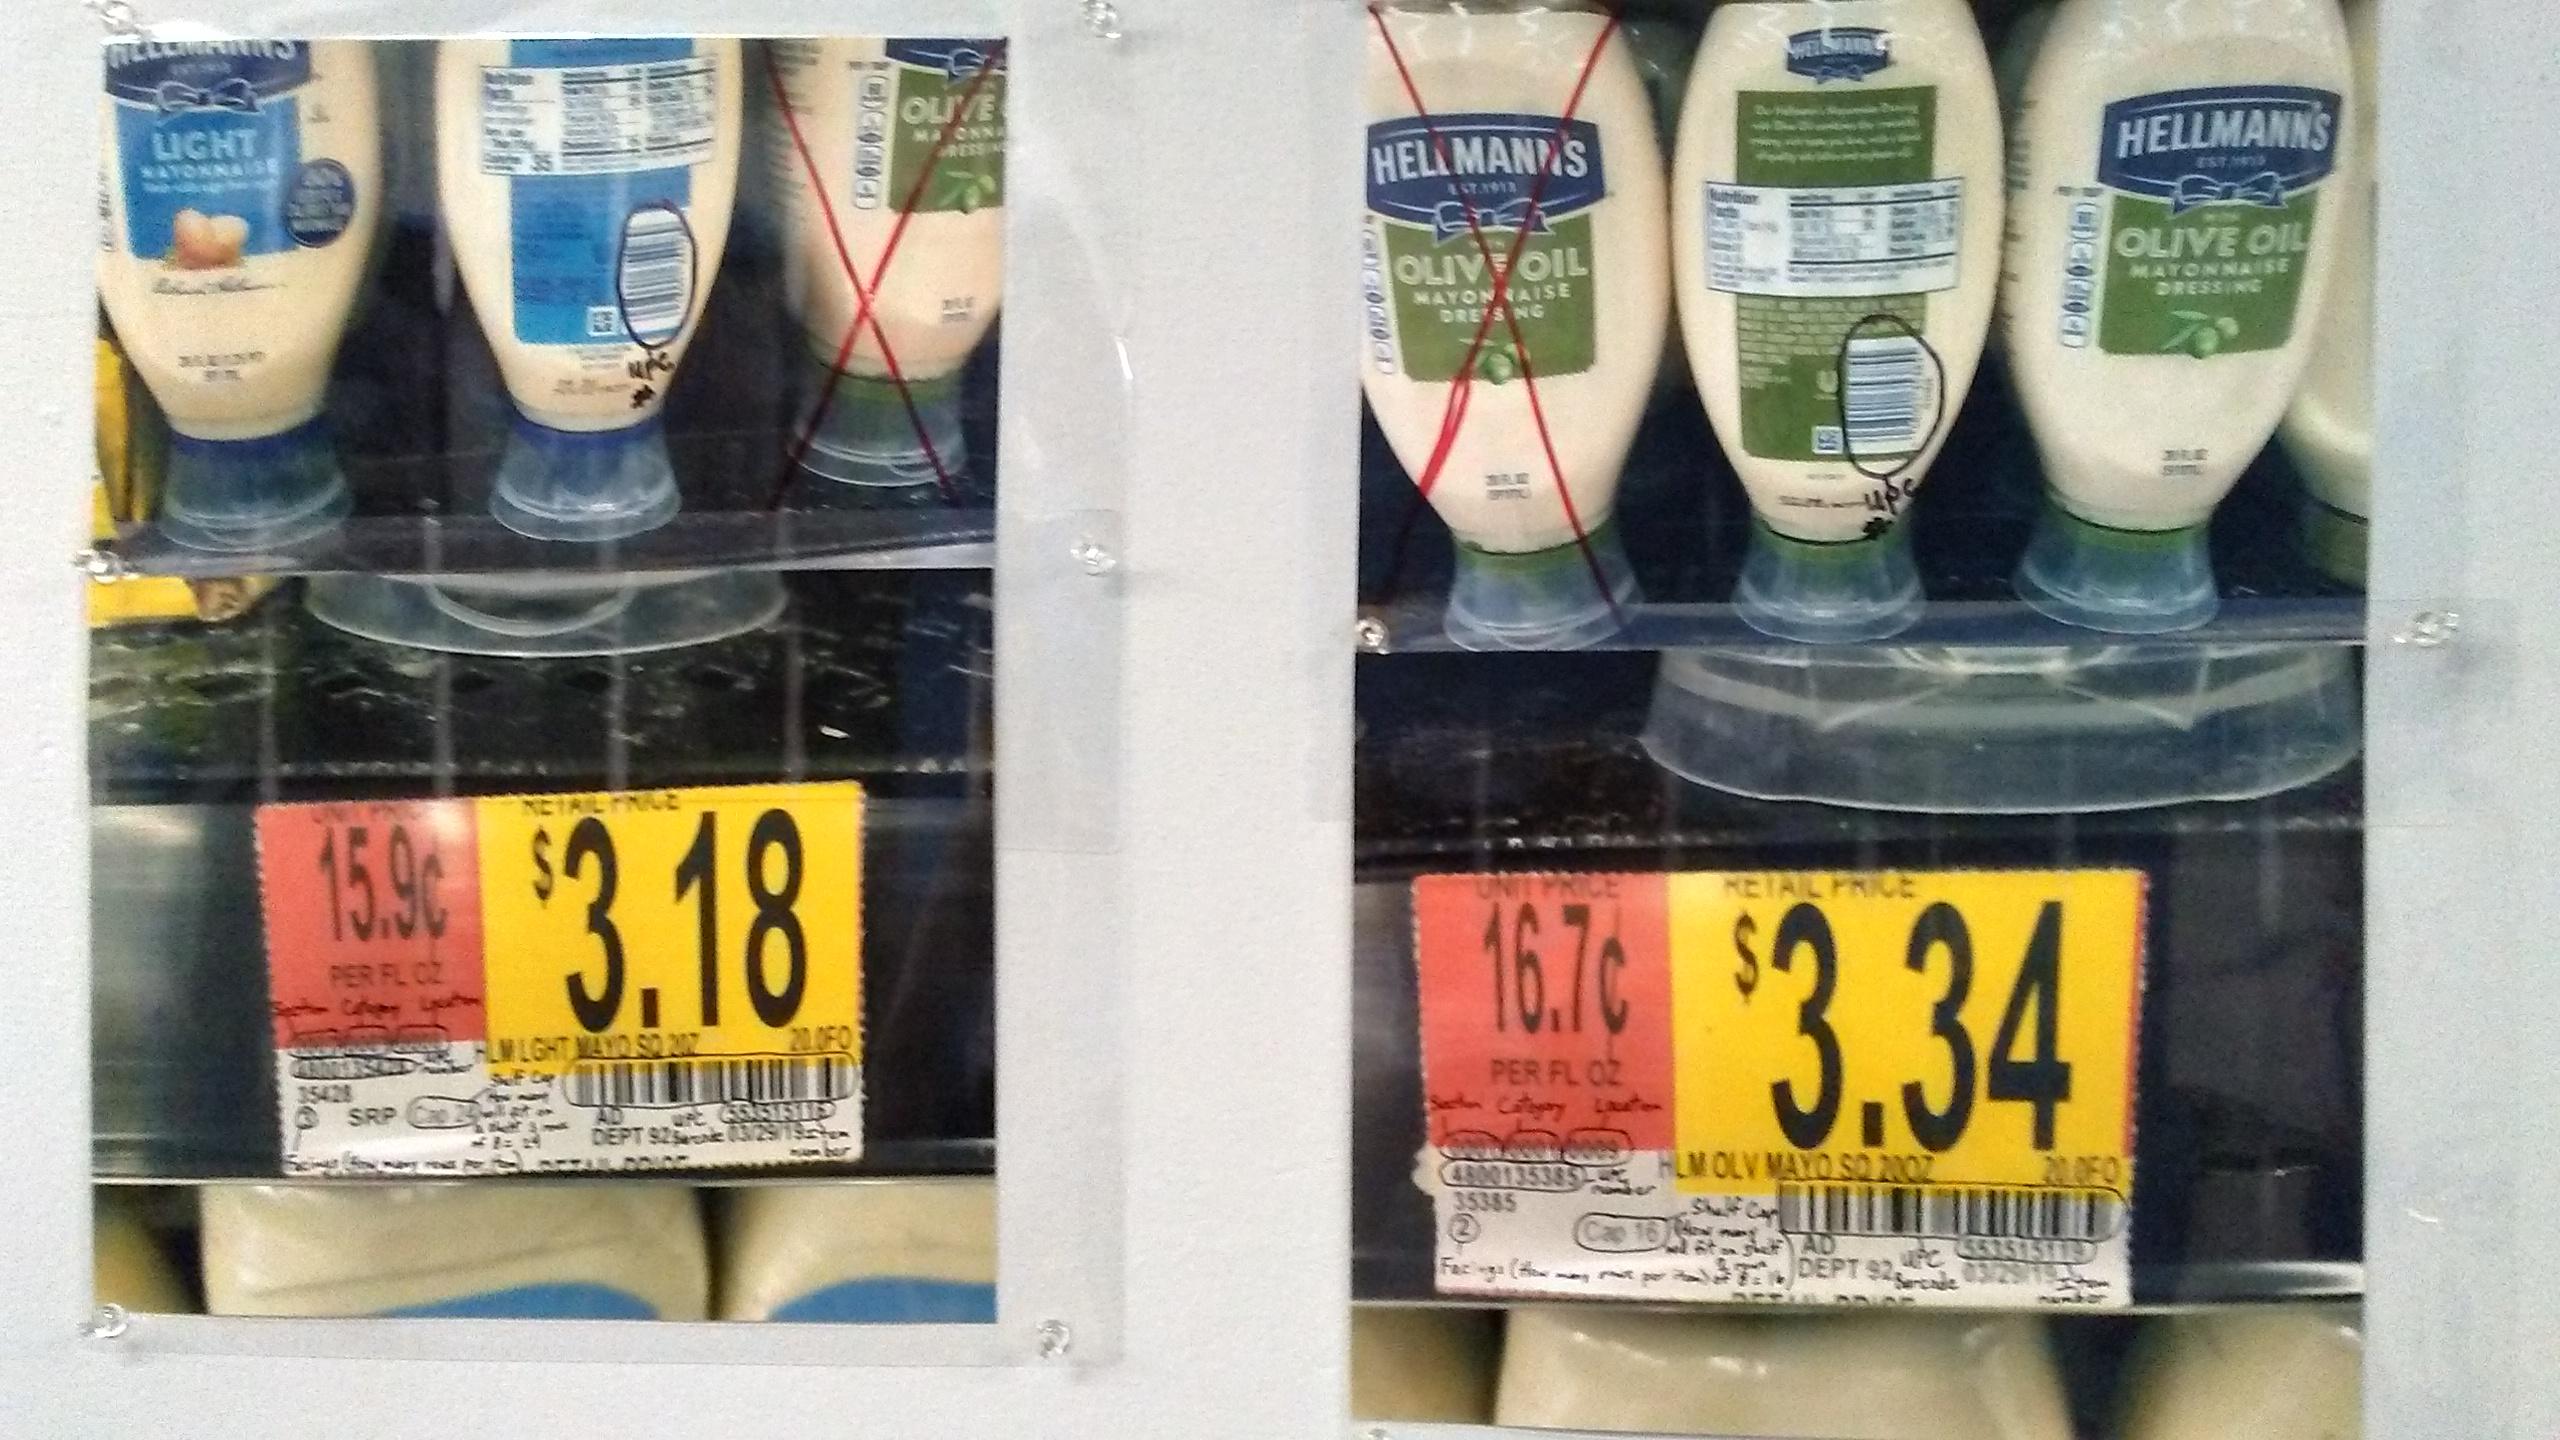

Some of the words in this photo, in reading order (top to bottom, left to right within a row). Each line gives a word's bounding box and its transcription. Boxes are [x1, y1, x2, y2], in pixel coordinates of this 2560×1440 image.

[2115, 101, 2332, 160] HELLMANN'S
[152, 128, 259, 161] LIGHT
[2114, 226, 2240, 259] OLIVE
[2246, 222, 2308, 256] OIL
[1394, 252, 1508, 287] OLIVE
[1517, 247, 1590, 283] OIL
[2129, 257, 2291, 279] MAYONNAISE
[2155, 279, 2263, 297] DRESSING
[1438, 303, 1545, 324] DRESNG
[1725, 877, 1819, 900] RETAIL
[1833, 876, 1916, 899] PRICE
[331, 963, 375, 988] PER
[379, 963, 406, 986] FL
[1491, 1058, 1543, 1086] PER
[1548, 1058, 1581, 1087] FL
[1587, 1058, 1624, 1087] OZ
[349, 1107, 397, 1127] SRP
[592, 1127, 643, 1145] DEPT
[1766, 1152, 1833, 1179] MAYO
[1454, 1191, 1517, 1213] 35385
[1803, 1233, 1837, 1255] AD
[1798, 1258, 1859, 1279] DEPT
